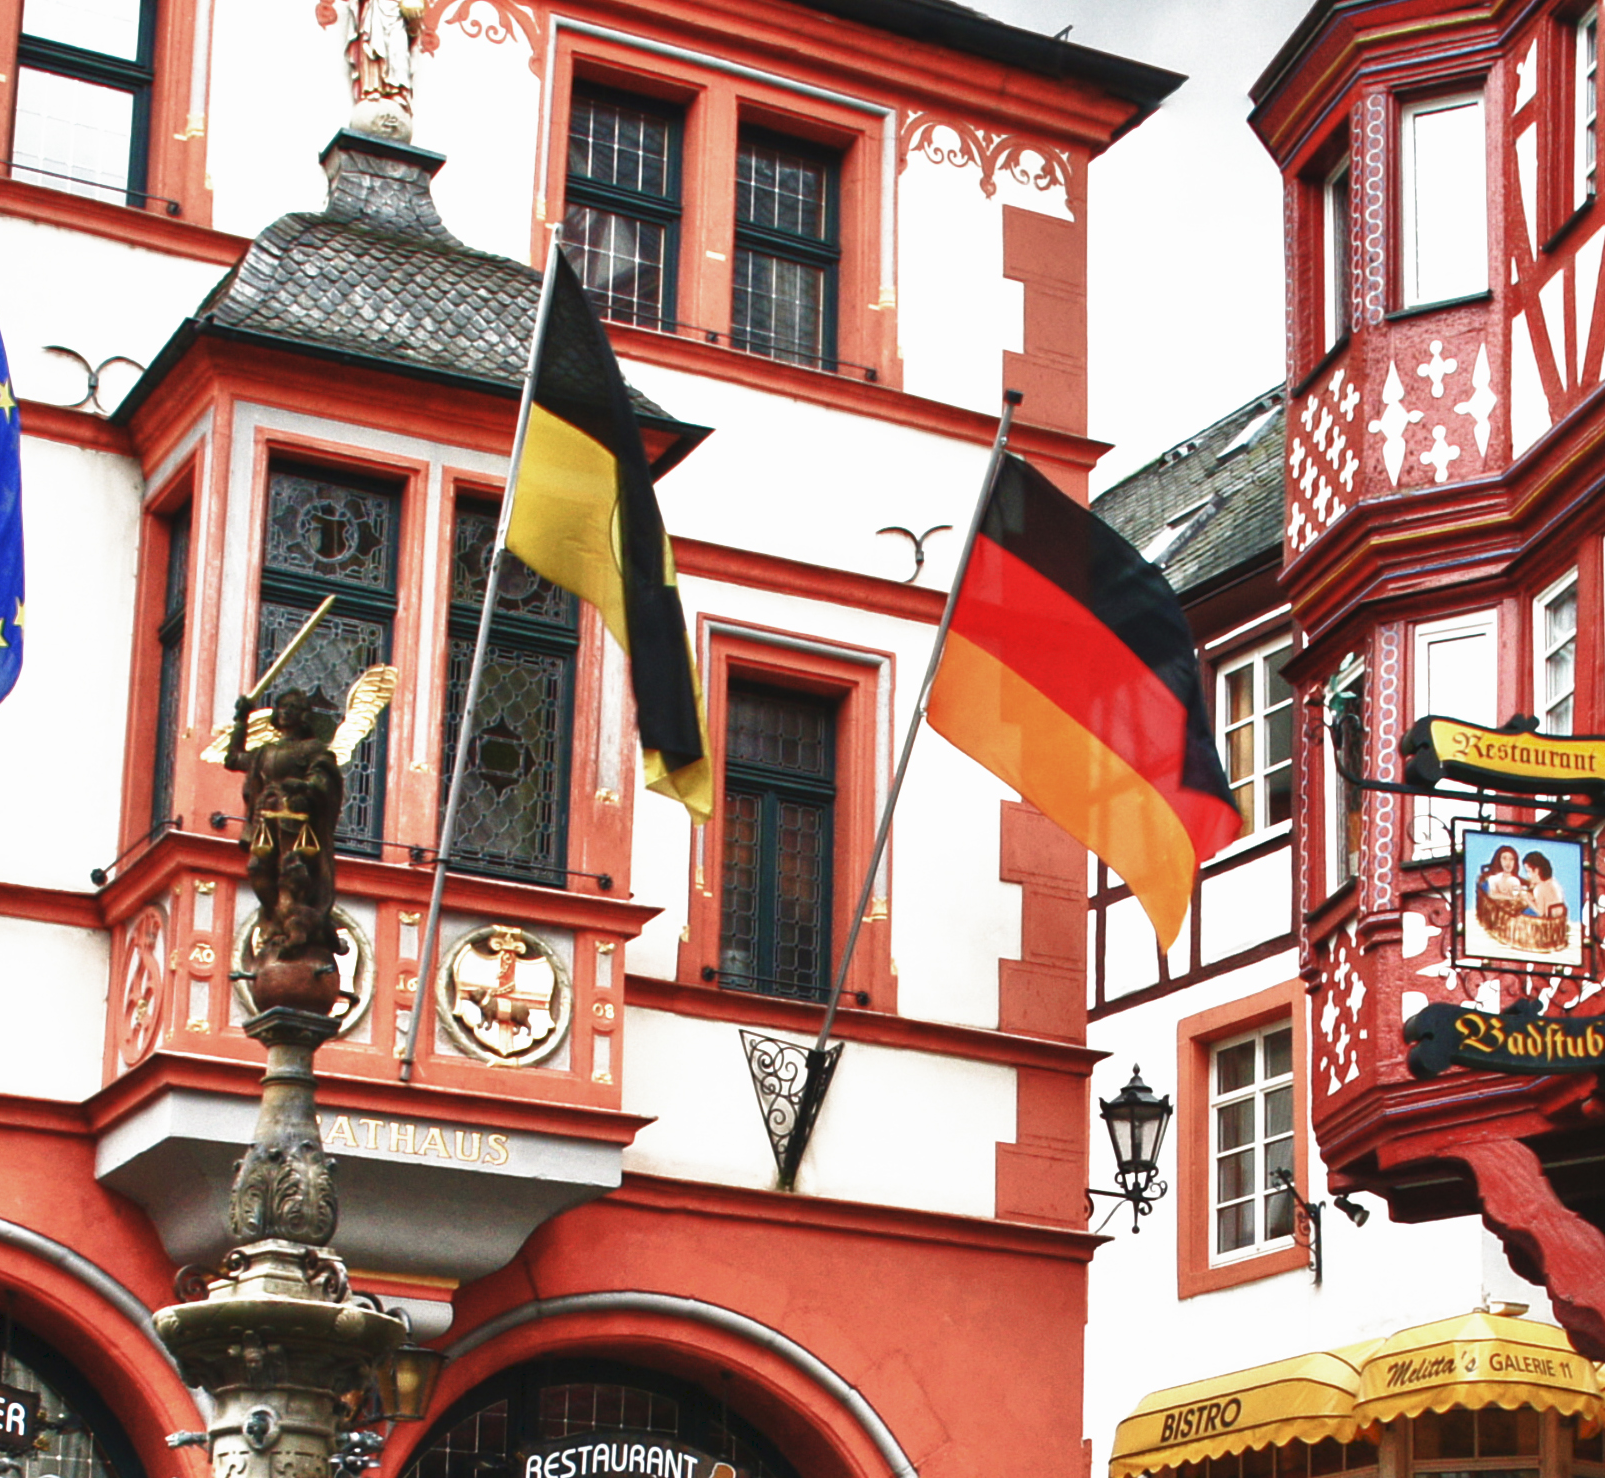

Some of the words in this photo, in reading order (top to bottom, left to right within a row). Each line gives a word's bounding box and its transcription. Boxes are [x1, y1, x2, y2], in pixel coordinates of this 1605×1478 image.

[1452, 732, 1597, 772] Restaurant
[592, 1003, 615, 1019] 08
[316, 1114, 509, 1166] ATHAUS
[1489, 1353, 1556, 1377] GALERIE
[1160, 1397, 1242, 1443] BISTRO
